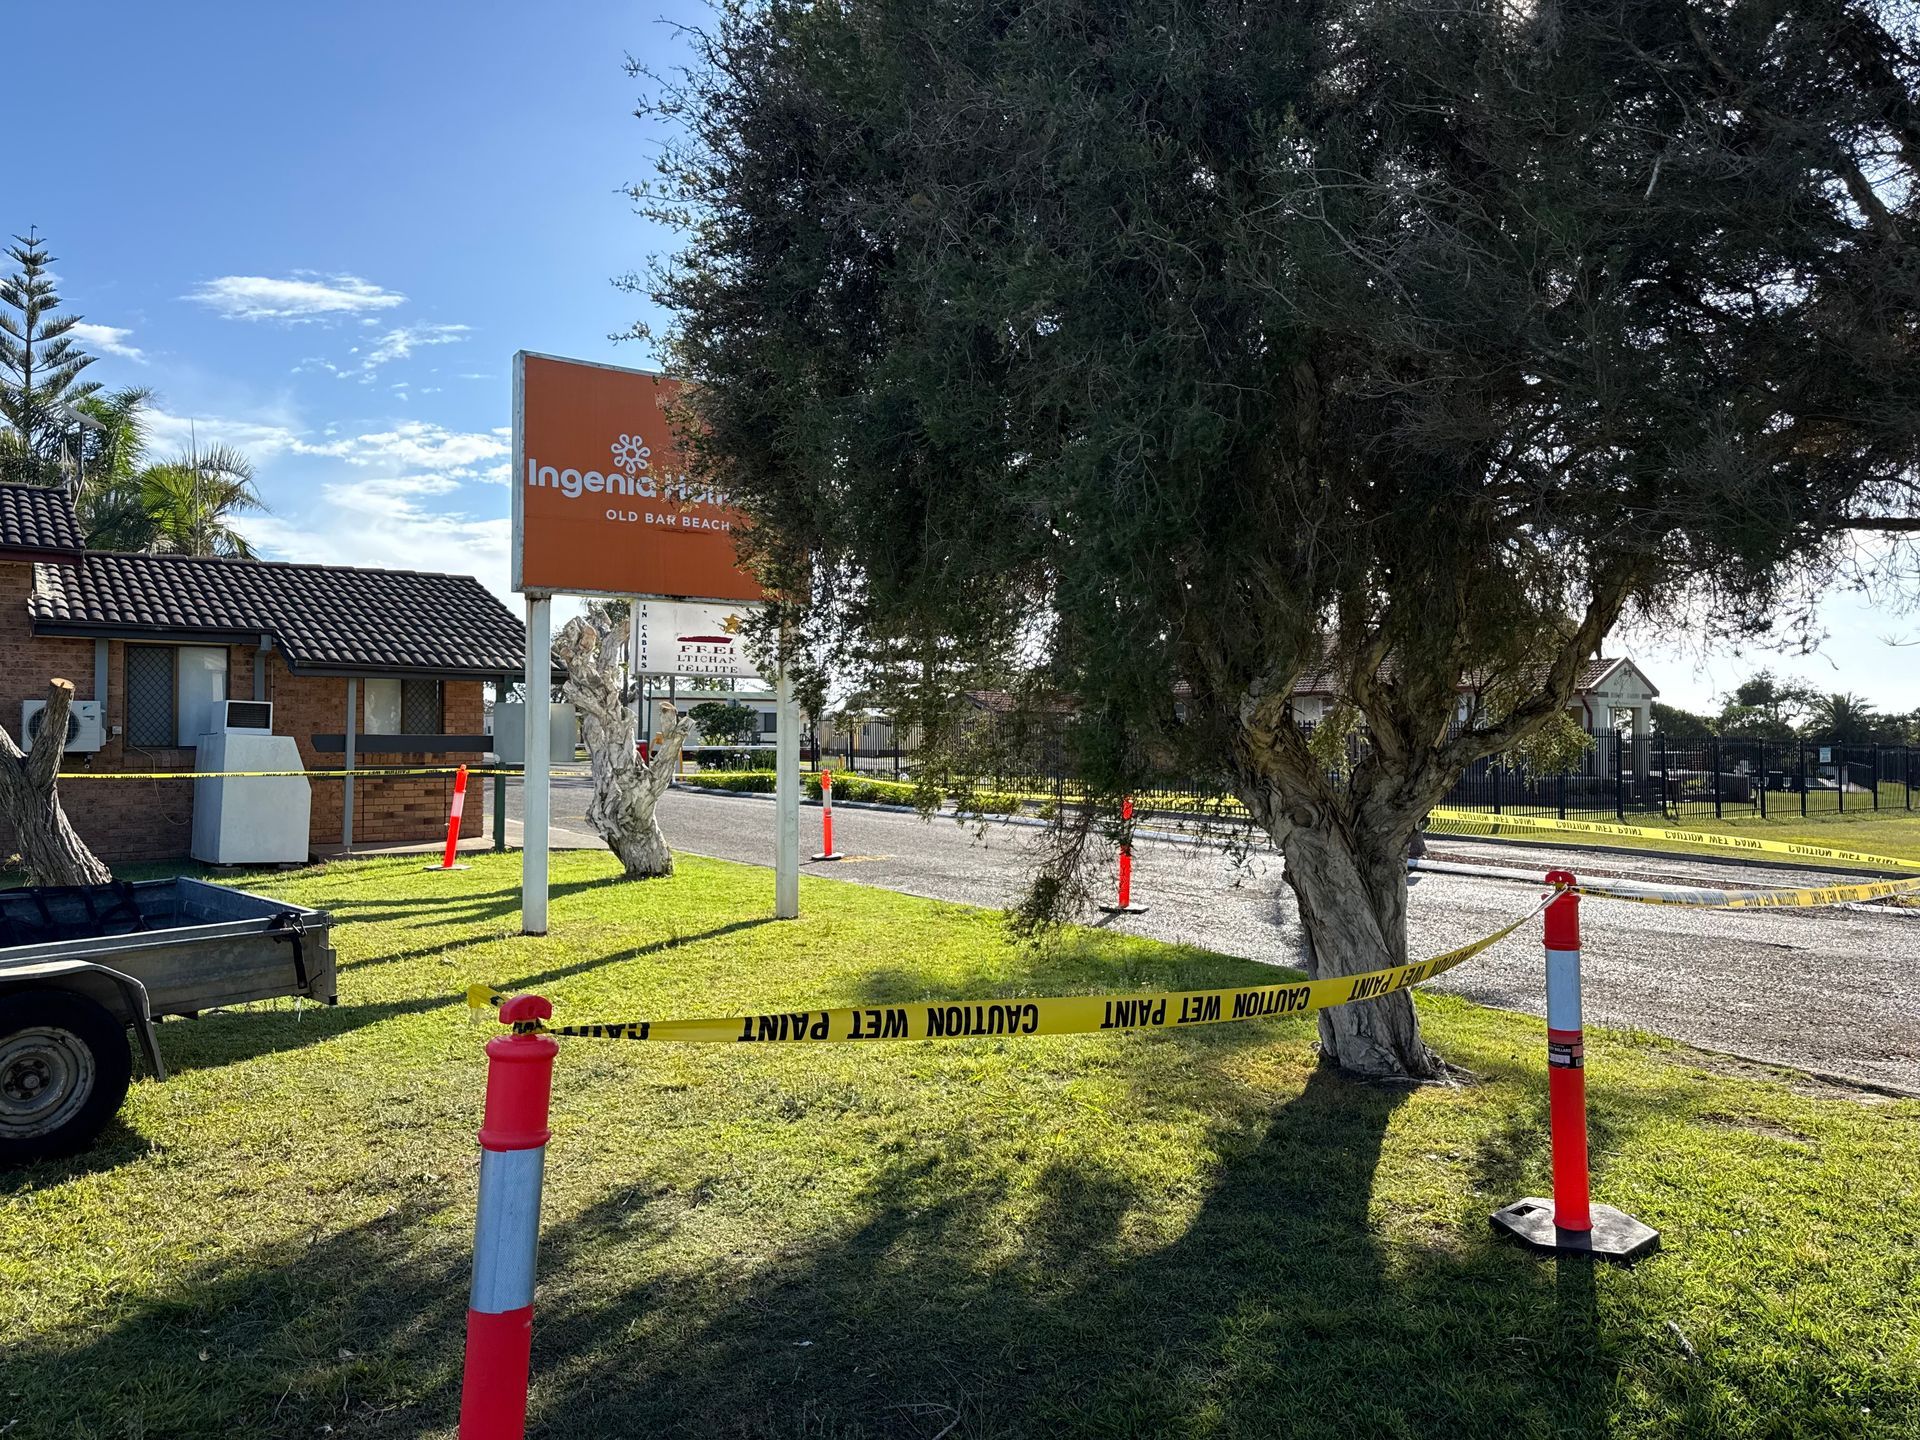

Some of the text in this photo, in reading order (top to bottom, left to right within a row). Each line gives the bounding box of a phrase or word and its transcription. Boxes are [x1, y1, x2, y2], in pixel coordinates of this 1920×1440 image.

[528, 458, 656, 498] Ingenia
[606, 509, 730, 531] OLD BAR BEACH
[641, 604, 648, 618] IN
[1347, 973, 1393, 1001] PAINT
[1394, 964, 1427, 990] WET
[1100, 986, 1311, 1030] CAUTION WET PAINT
[550, 1021, 651, 1041] CAUT
[737, 1003, 1038, 1042] CAUTION WET PAINT
